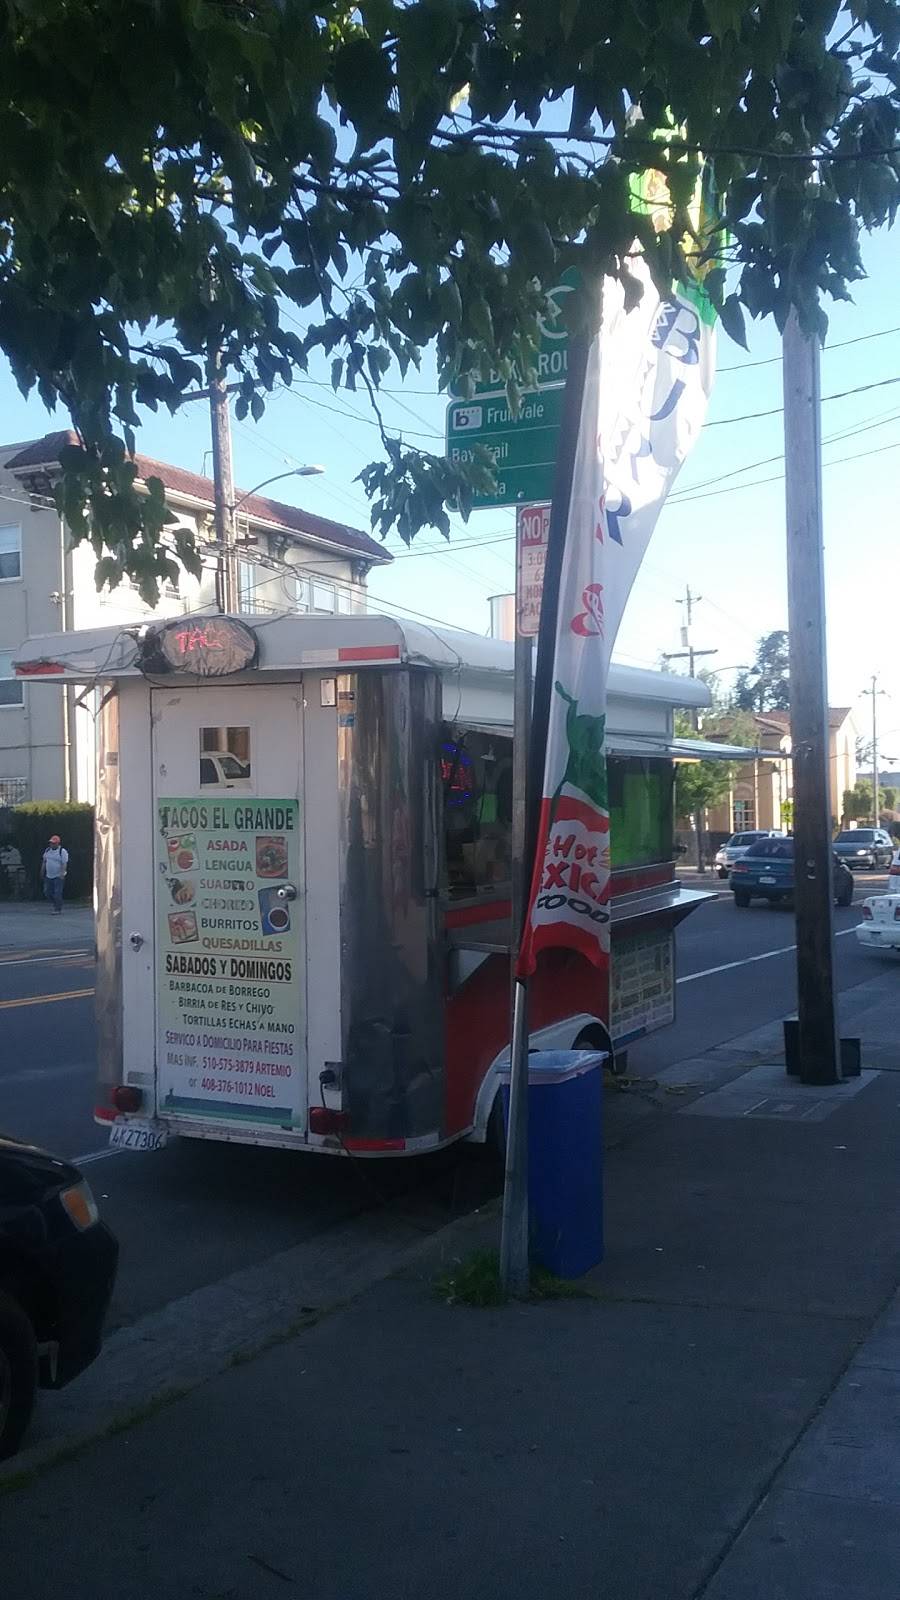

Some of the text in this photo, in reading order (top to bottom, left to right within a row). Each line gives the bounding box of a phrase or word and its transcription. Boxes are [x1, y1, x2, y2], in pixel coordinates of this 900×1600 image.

[522, 516, 542, 540] NO
[159, 806, 294, 831] TACOS EL GRANDE
[206, 839, 248, 852] ASADA
[204, 860, 253, 872] LENGUA
[199, 878, 255, 891] SUADERO
[201, 918, 259, 931] BURRITOS
[201, 936, 283, 953] QUESADILLAS
[165, 954, 292, 981] SABADOS Y DOMINGOS
[169, 980, 214, 994] BARBACOA
[229, 984, 271, 998] BORREGO
[178, 996, 206, 1009] BIRRIA
[221, 1000, 236, 1012] RES
[246, 1002, 274, 1015] CHIVO
[182, 1013, 227, 1029] TORTILLAS
[229, 1018, 257, 1031] ECHAS
[267, 1022, 295, 1034] MANO
[203, 1034, 242, 1052] DOMICILIO
[243, 1038, 263, 1053] PARA
[264, 1040, 293, 1056] FIESTAS
[166, 1052, 183, 1066] MAS
[202, 1055, 255, 1074] 510-575-3879
[256, 1064, 292, 1078] ARTEMIO
[254, 1084, 276, 1098] NOEL
